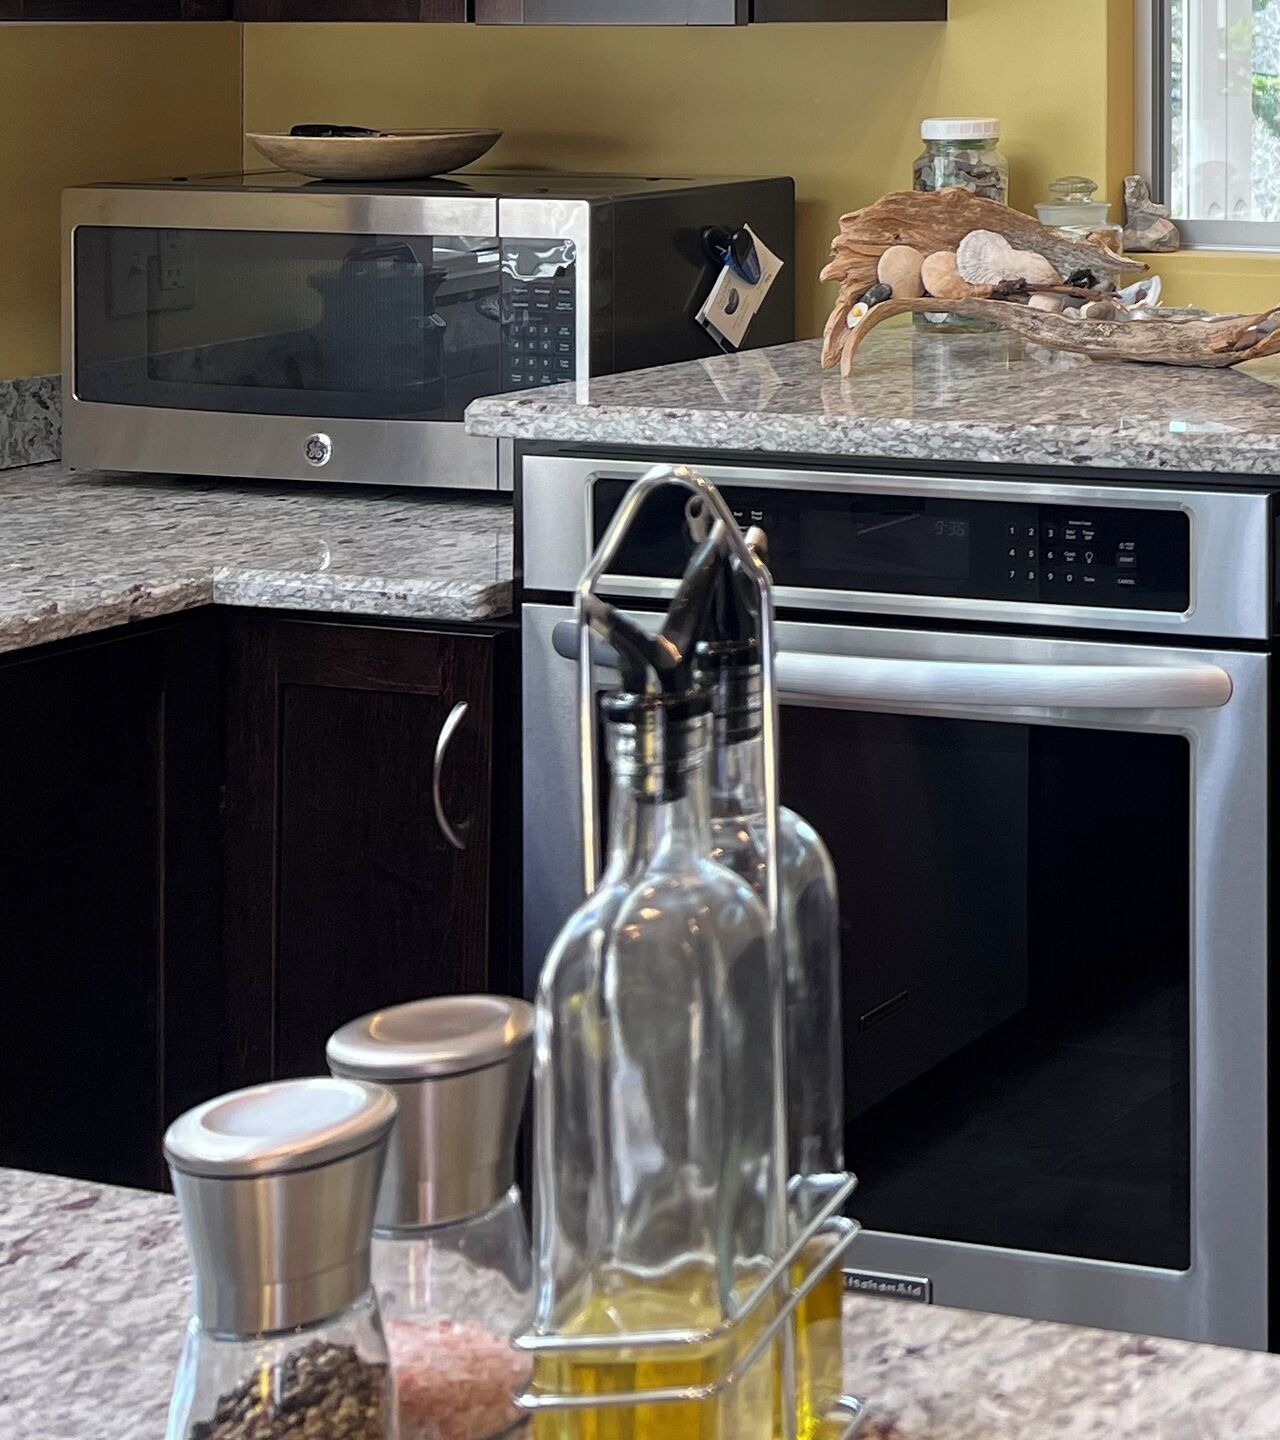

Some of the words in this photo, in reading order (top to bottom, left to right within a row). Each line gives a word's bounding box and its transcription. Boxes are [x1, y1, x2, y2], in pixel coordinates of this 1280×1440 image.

[935, 519, 966, 538] 9:36
[1009, 526, 1015, 535] 1
[1028, 527, 1035, 536] 2
[1009, 548, 1016, 556] 4
[1028, 549, 1035, 558] 5
[1047, 551, 1054, 559] 6
[1009, 570, 1015, 578] 7
[1028, 571, 1035, 580] 8
[1047, 572, 1054, 580] 9
